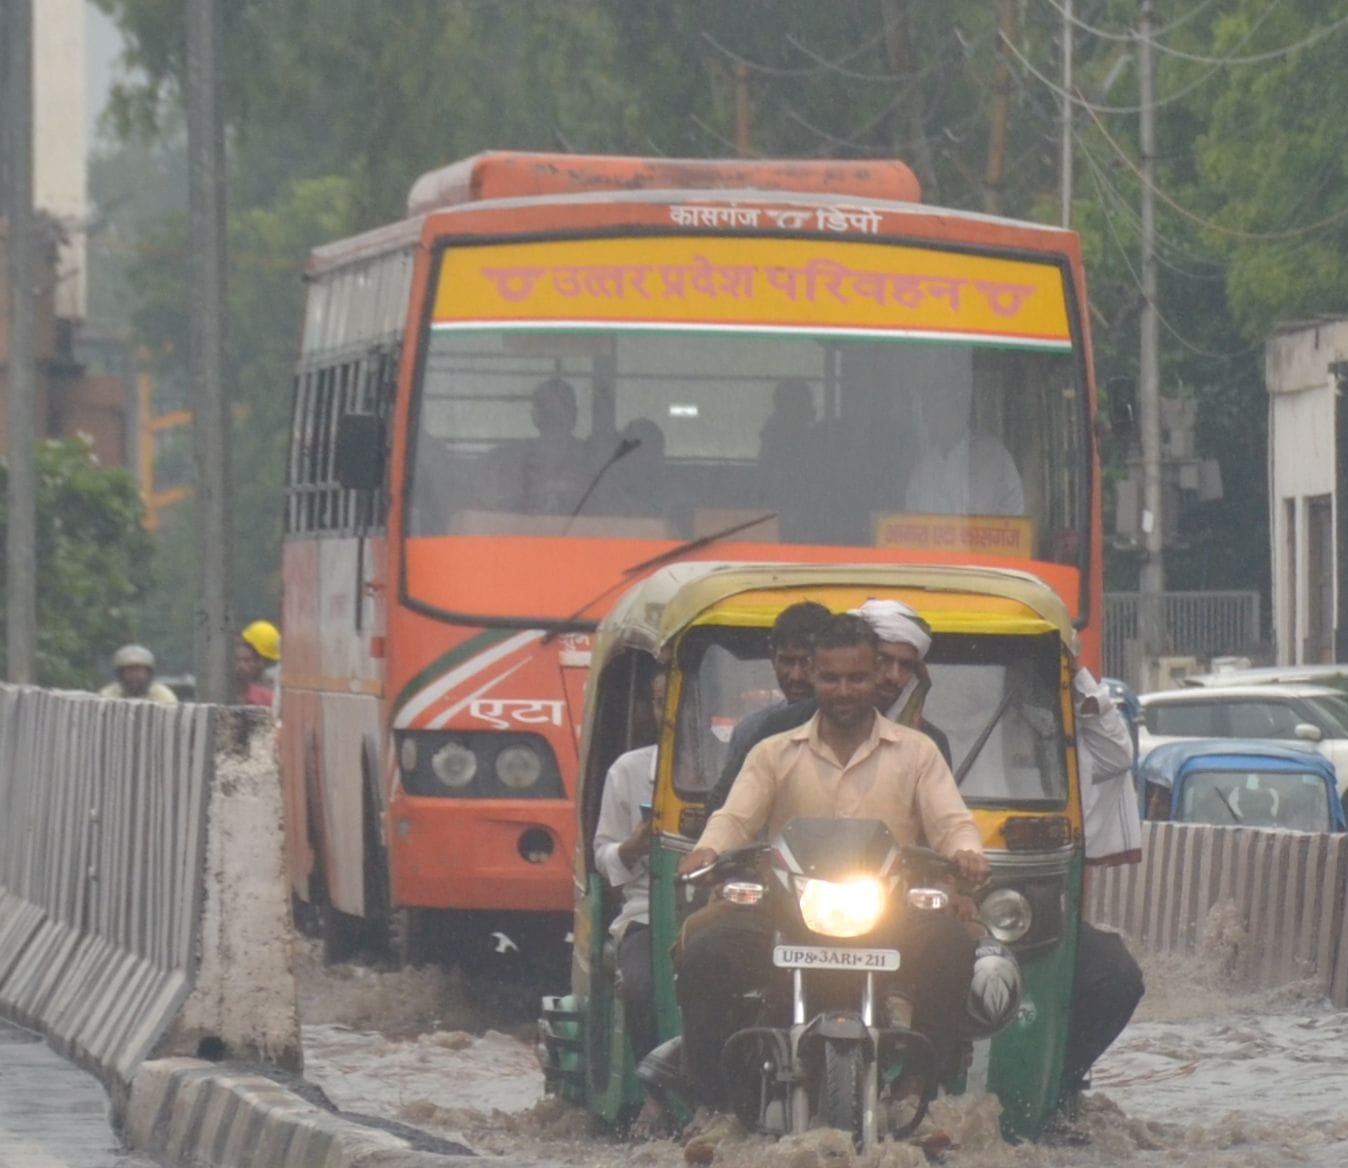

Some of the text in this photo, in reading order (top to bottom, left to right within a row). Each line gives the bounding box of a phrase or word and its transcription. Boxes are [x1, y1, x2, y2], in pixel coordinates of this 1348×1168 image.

[669, 203, 882, 234] कासगंज डिपो
[551, 253, 968, 313] उत्तर प्रदेश परिवहन
[469, 698, 566, 730] एटा
